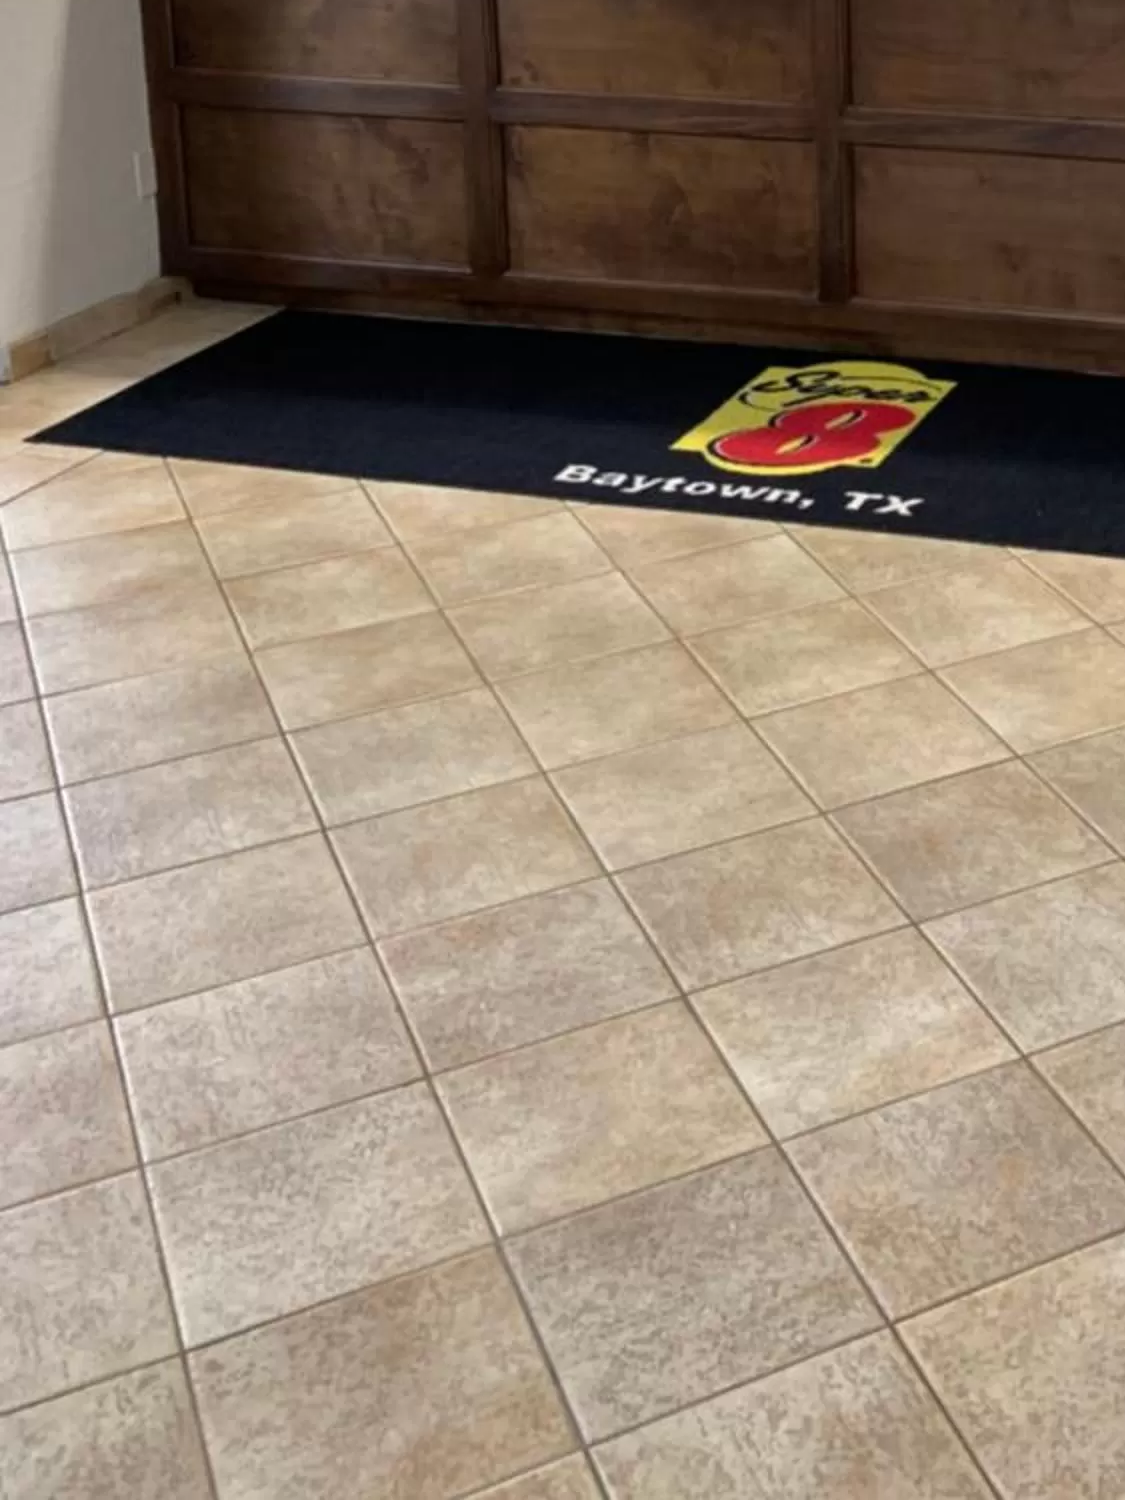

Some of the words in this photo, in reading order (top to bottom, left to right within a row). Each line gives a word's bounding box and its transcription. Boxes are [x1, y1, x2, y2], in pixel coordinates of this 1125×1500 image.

[751, 370, 938, 408] Super
[704, 402, 917, 468] 8
[553, 464, 816, 510] Baytown,
[843, 490, 925, 518] TX
